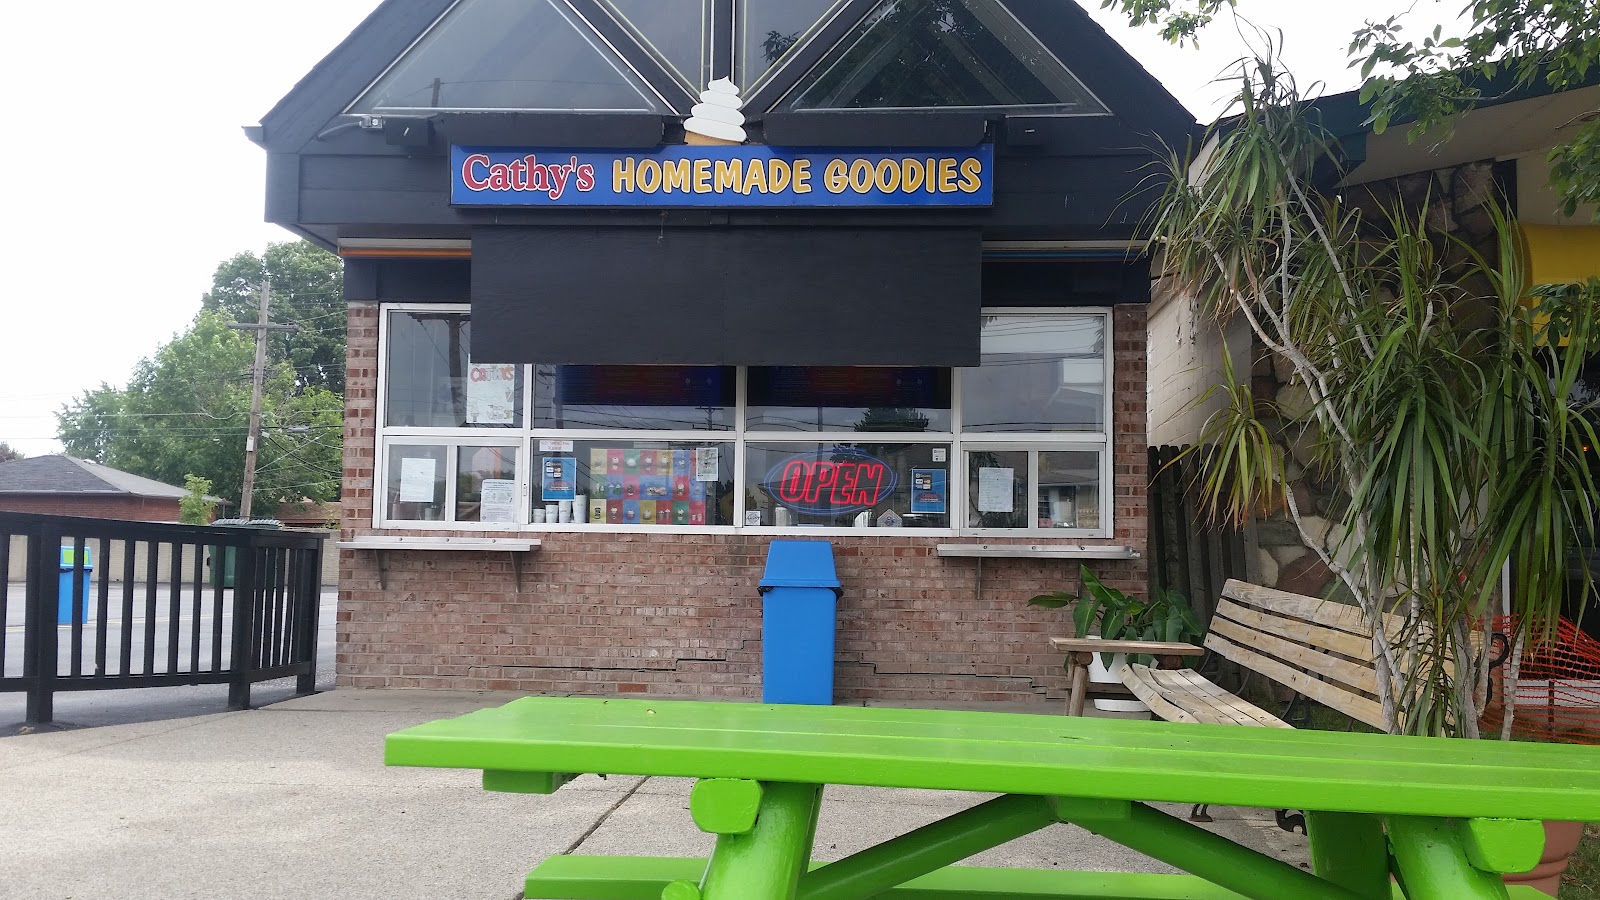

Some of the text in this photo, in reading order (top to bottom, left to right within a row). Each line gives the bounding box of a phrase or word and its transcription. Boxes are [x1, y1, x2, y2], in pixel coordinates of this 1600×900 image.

[462, 154, 982, 200] Cathy's HOMEMADE GOODIES
[780, 460, 884, 506] OPEN
